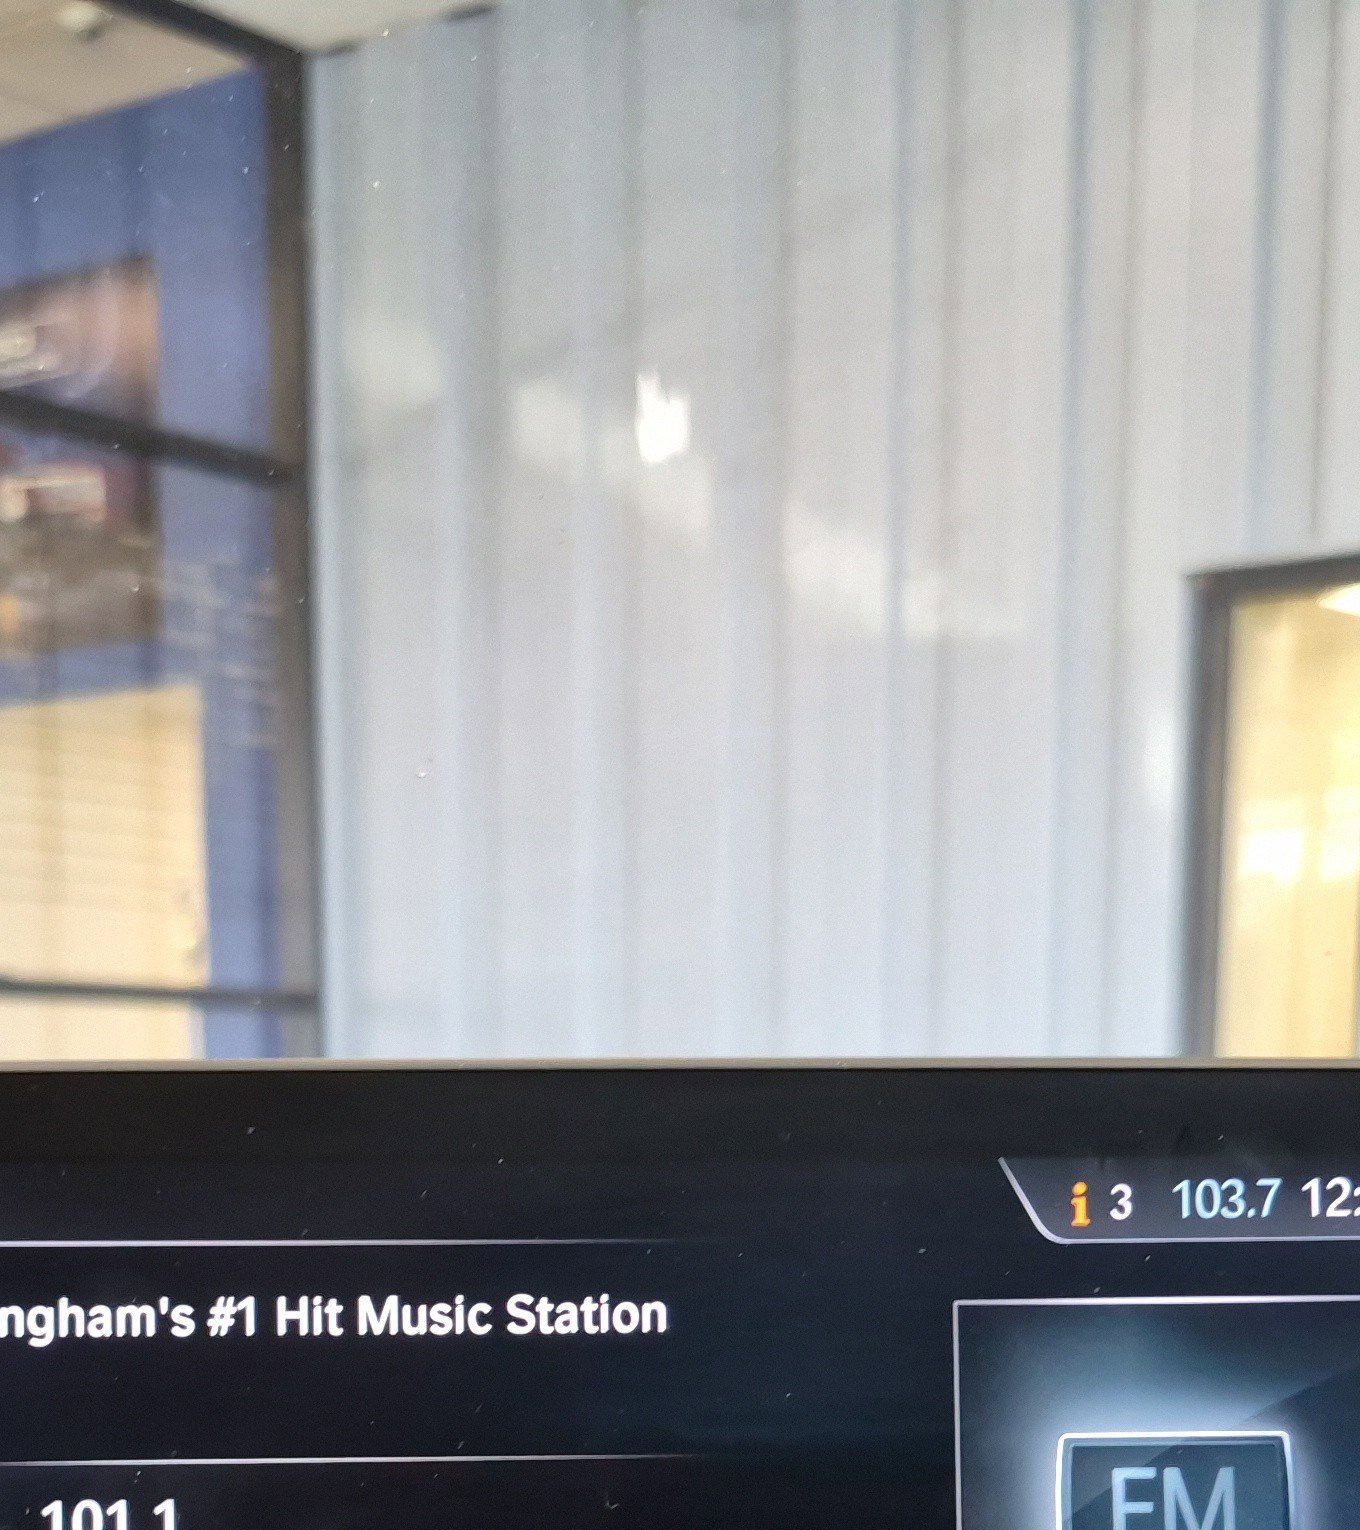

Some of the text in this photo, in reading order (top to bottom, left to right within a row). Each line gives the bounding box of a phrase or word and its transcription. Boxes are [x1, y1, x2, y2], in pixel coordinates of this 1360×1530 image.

[1108, 1182, 1134, 1221] 3
[1171, 1177, 1283, 1221] 103.7
[206, 1295, 257, 1338] #1
[276, 1295, 344, 1337] Hit
[357, 1294, 493, 1337] Music
[506, 1292, 669, 1336] Station
